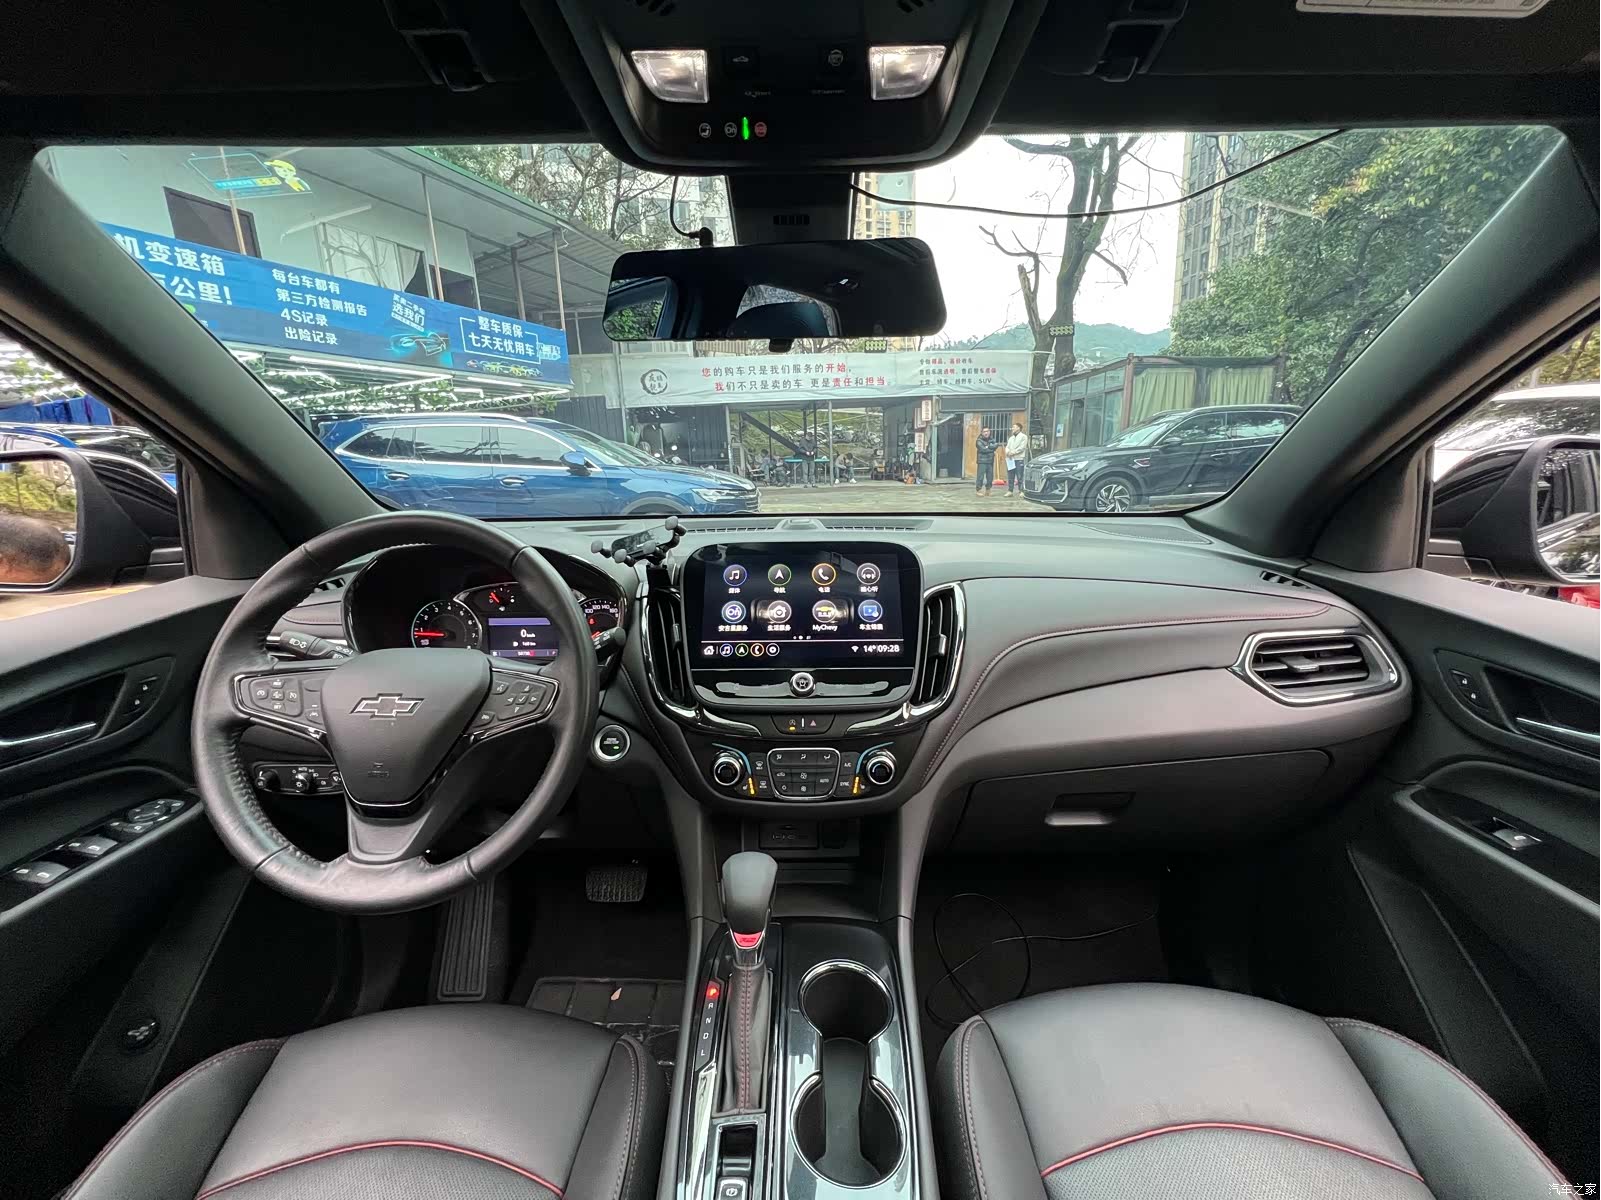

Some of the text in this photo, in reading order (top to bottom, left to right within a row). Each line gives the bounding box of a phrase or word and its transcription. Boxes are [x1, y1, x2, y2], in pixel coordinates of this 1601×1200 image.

[113, 232, 226, 277] 机变速箱
[272, 268, 340, 294] 每台车都有
[275, 287, 367, 317] 第三方检测报告
[280, 307, 328, 327] 4S记录
[392, 301, 425, 327] 选我们
[284, 326, 338, 345] 出险记录
[477, 315, 523, 338] 整车质保
[468, 332, 536, 357] 七天无忧用车
[714, 379, 804, 392] 我们不只是卖的车
[520, 628, 527, 638] 0
[812, 624, 838, 632] MyChevy
[878, 644, 900, 652] 09:28
